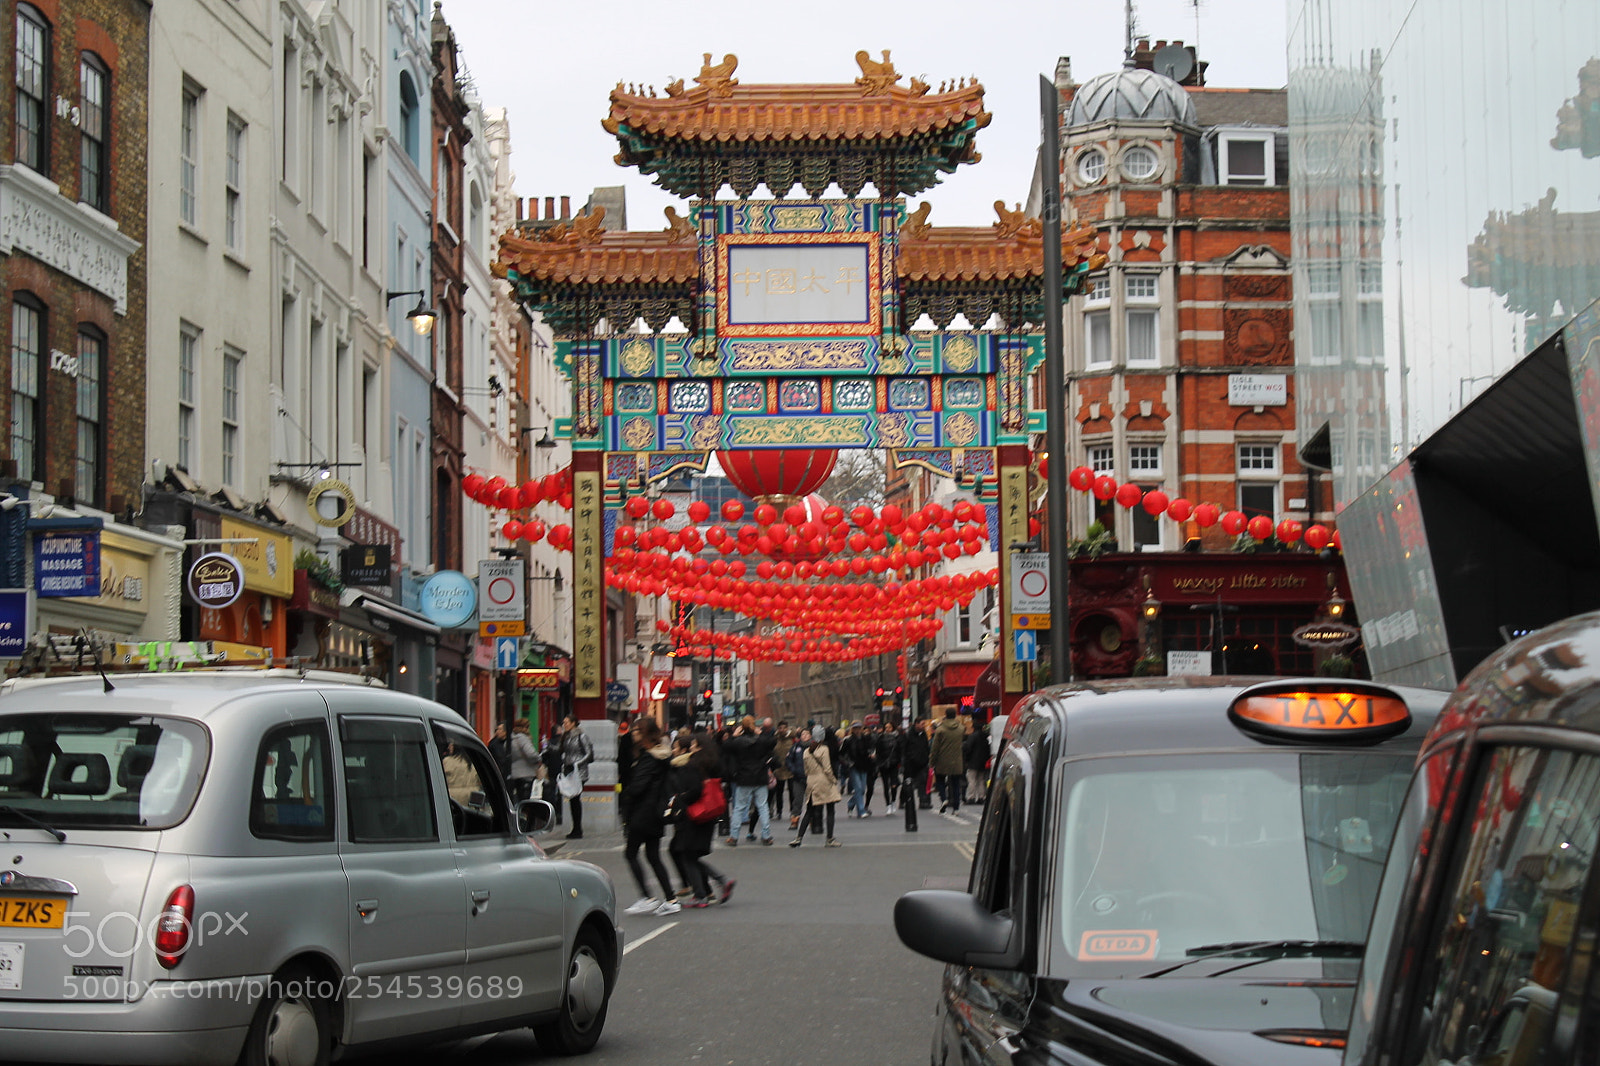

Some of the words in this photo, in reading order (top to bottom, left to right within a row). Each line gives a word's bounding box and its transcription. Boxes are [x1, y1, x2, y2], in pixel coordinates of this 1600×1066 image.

[1232, 384, 1262, 392] STREET
[41, 538, 83, 554] ACUPUNCTURE
[41, 559, 83, 570] MASSAGE
[1020, 561, 1046, 569] ZONE
[488, 568, 515, 576] ZONE
[1302, 632, 1321, 640] SPICE
[1276, 697, 1374, 725] TAXI
[12, 901, 53, 923] ZKS
[1095, 939, 1141, 950] LTDA
